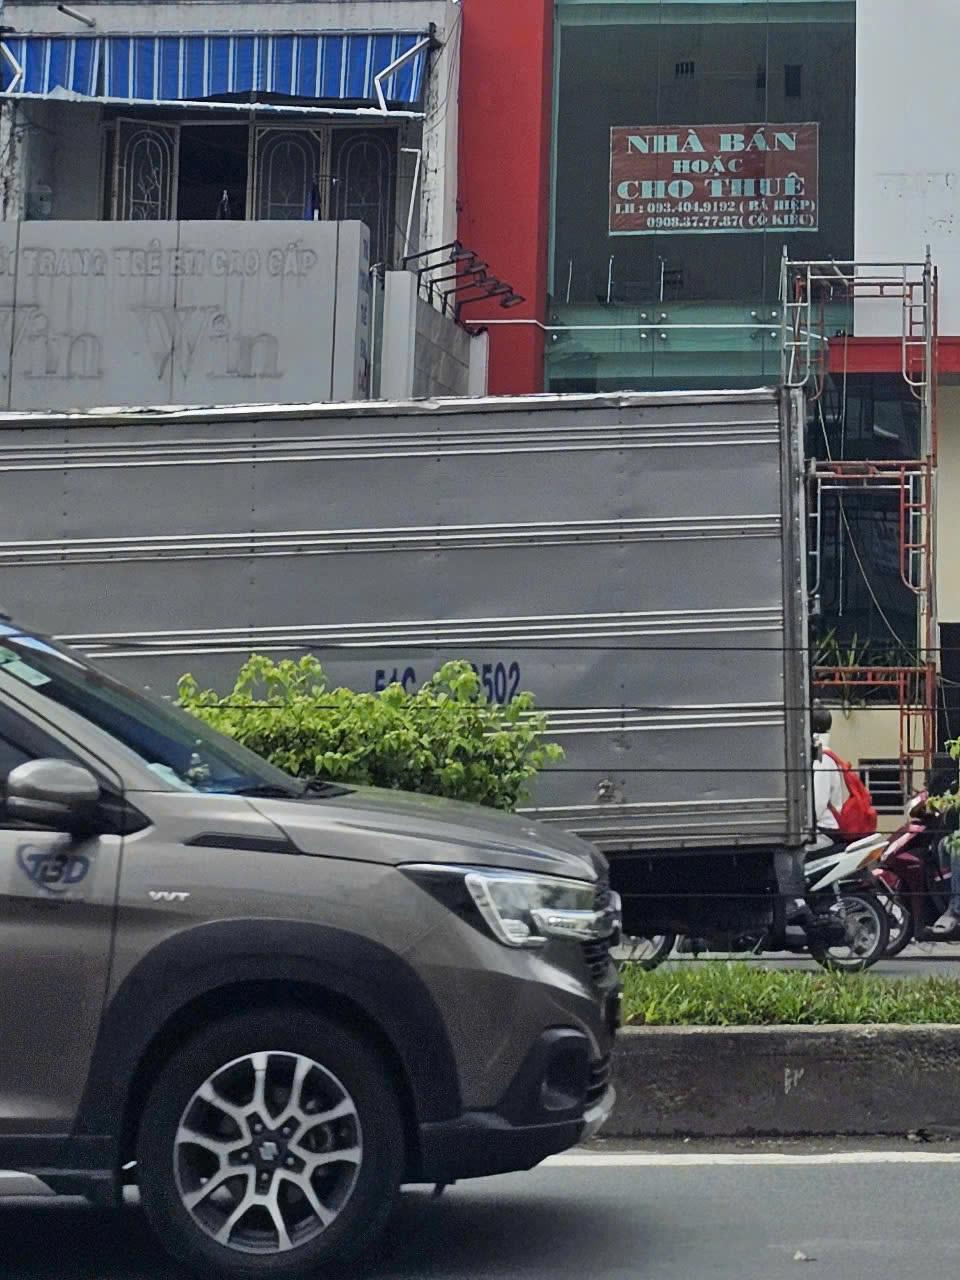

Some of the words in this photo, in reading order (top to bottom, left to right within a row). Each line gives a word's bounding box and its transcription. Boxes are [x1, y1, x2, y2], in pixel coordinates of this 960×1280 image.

[626, 128, 705, 154] NHÀ
[718, 127, 797, 152] BÁN
[672, 155, 743, 177] HOẶC
[616, 179, 694, 200] CHO
[704, 171, 806, 198] THUÊ
[647, 201, 736, 214] 093.404.9192
